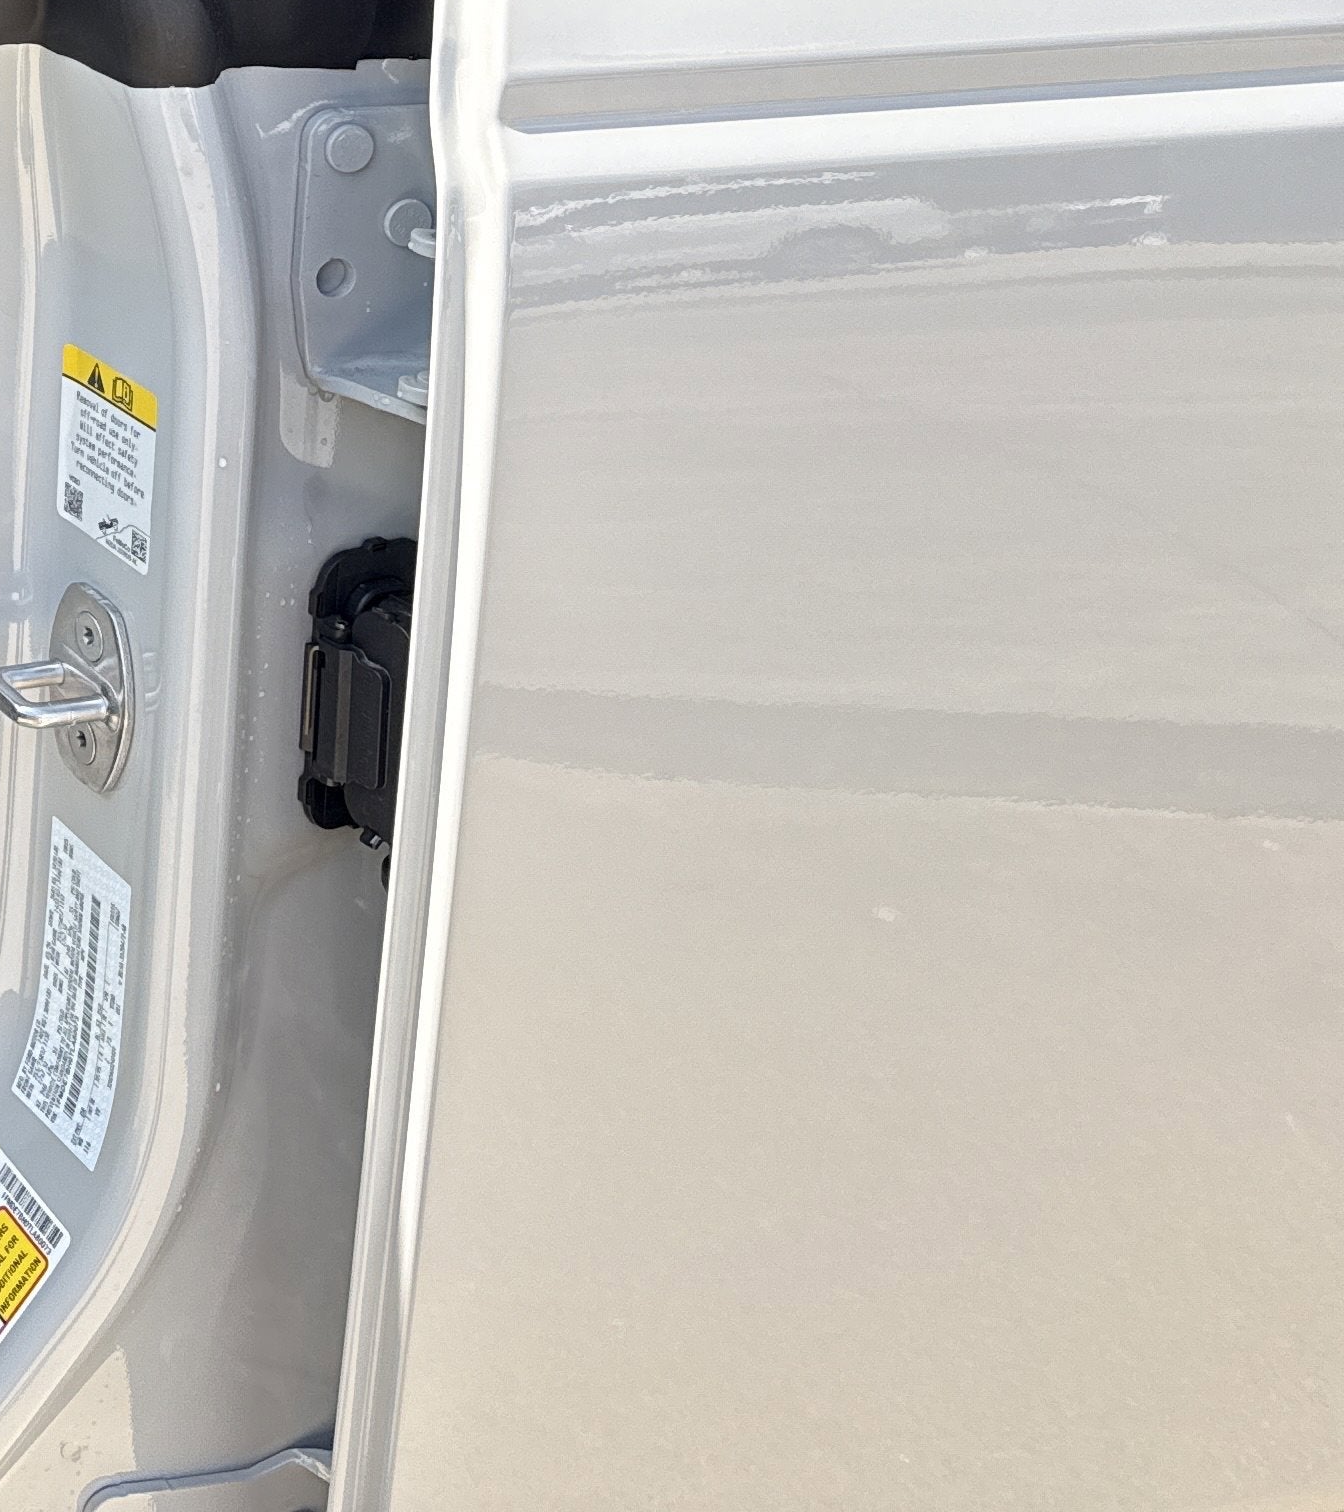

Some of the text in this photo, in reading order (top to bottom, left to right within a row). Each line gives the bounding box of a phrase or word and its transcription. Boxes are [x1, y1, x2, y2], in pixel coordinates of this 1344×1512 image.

[110, 412, 127, 432] doors
[130, 424, 140, 440] for
[3, 1233, 19, 1254] FOR
